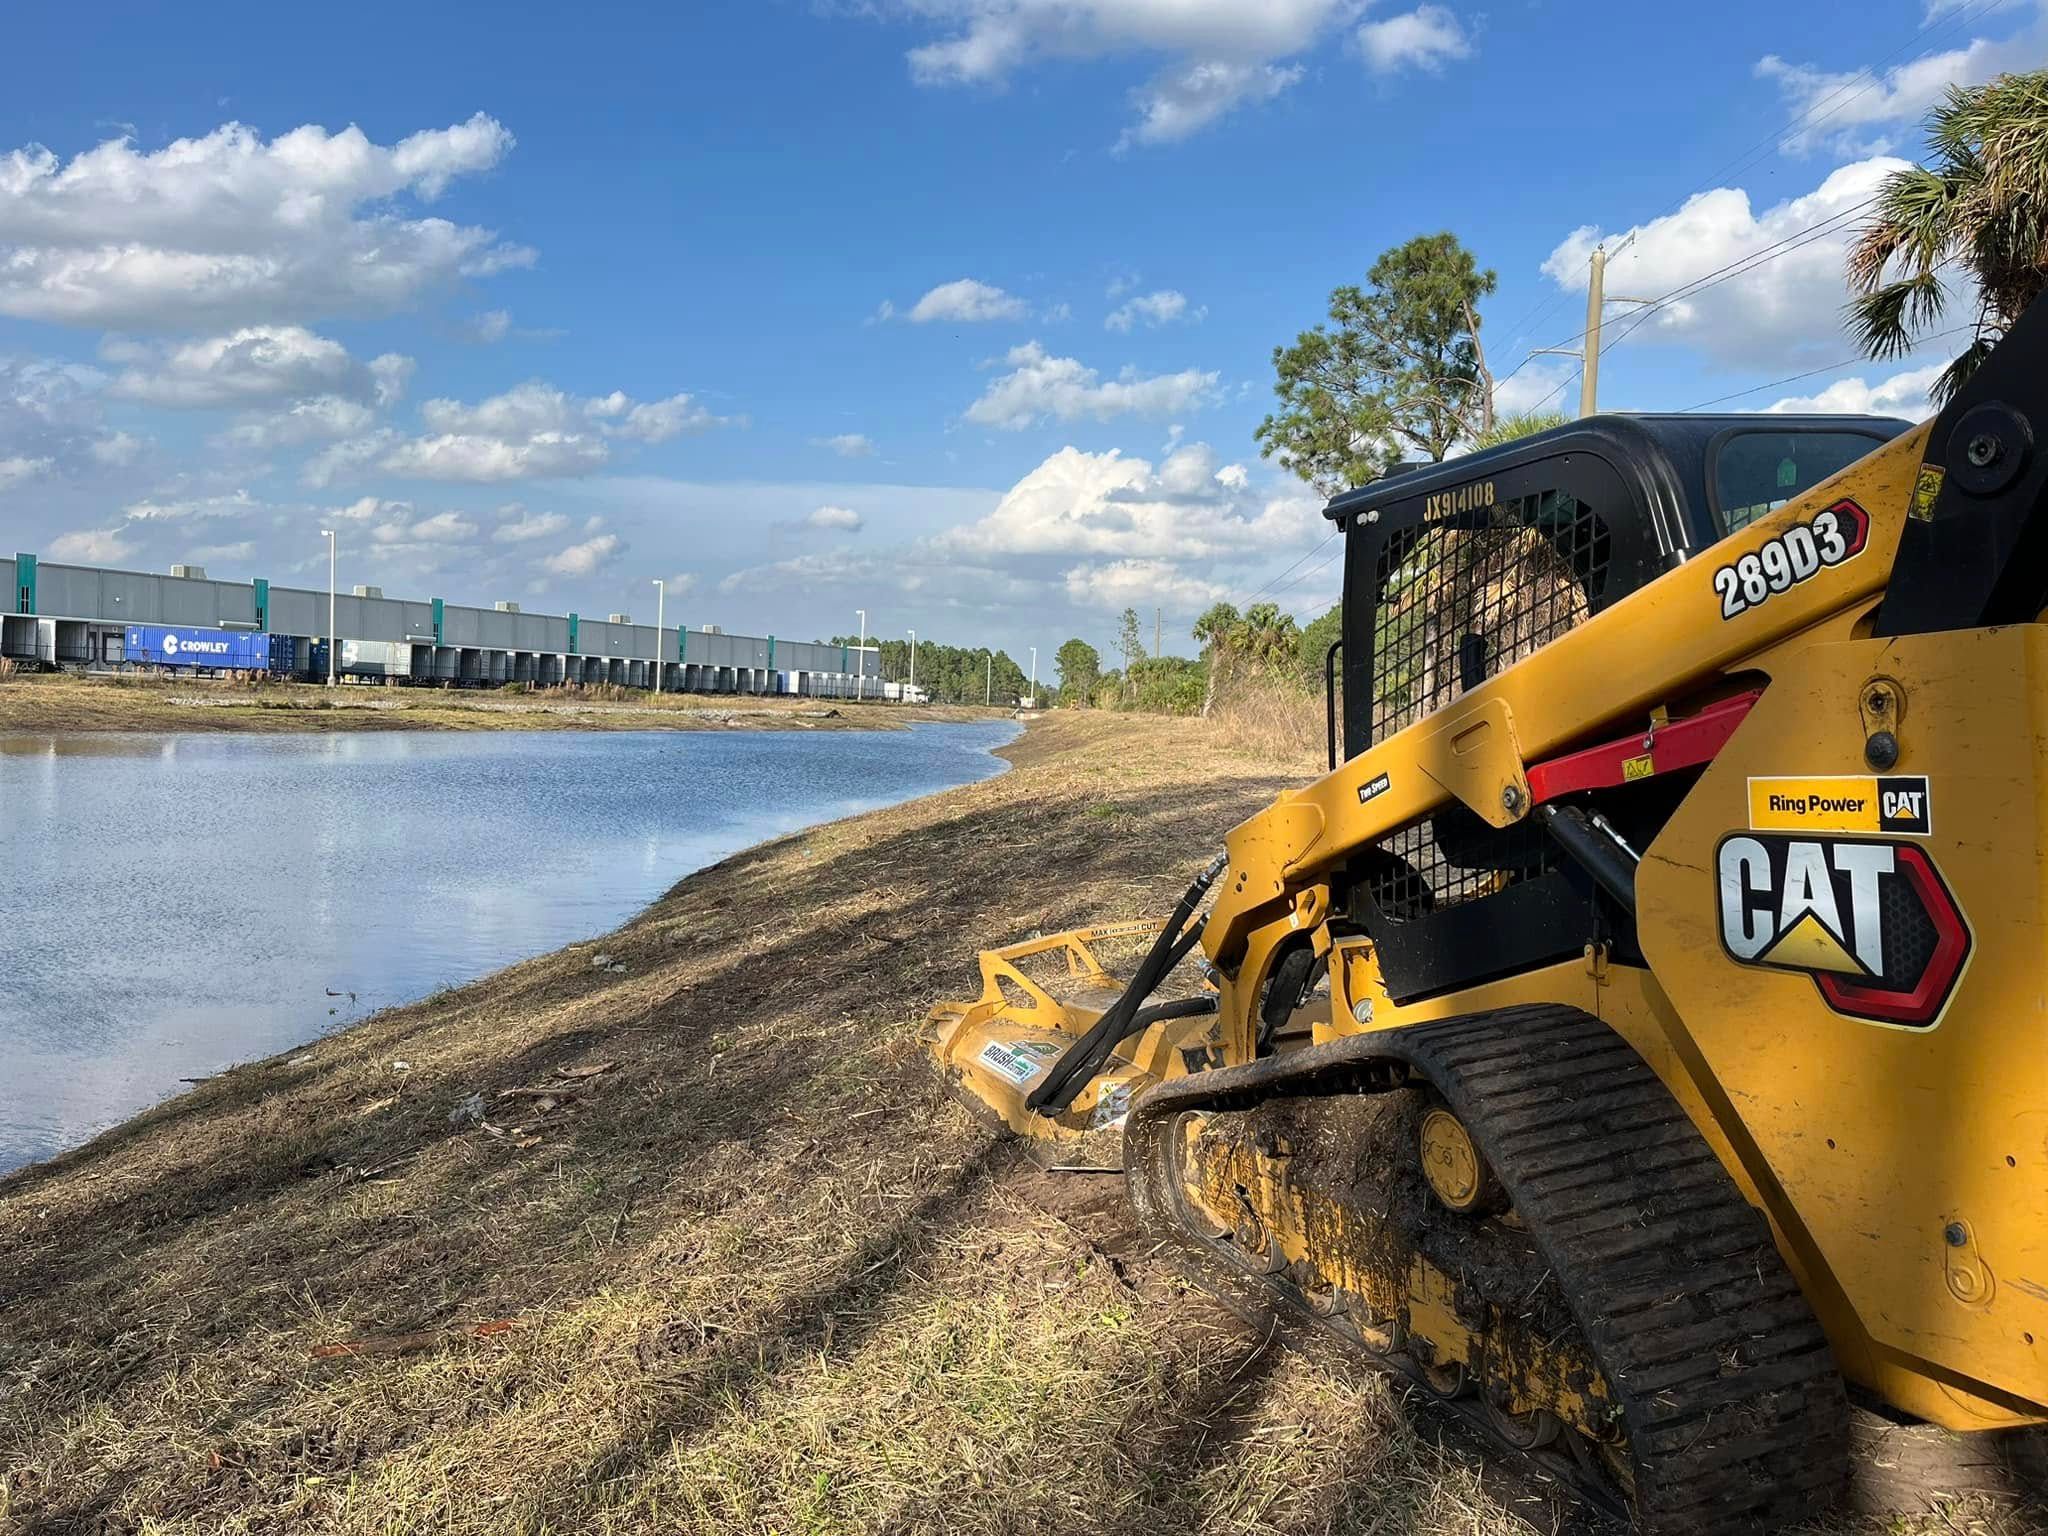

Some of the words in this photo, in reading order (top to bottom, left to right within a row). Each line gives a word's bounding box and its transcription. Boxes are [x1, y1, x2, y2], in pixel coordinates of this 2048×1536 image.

[1424, 481, 1494, 522] JX914108
[1715, 512, 1846, 618] 289D3
[181, 640, 229, 653] CROWLEY
[1769, 795, 1806, 814] Ring
[1809, 795, 1865, 812] Power
[1883, 792, 1922, 818] CAT
[1719, 837, 1895, 977] CAT
[1142, 922, 1157, 930] CUT
[983, 1045, 1017, 1069] BRUSH
